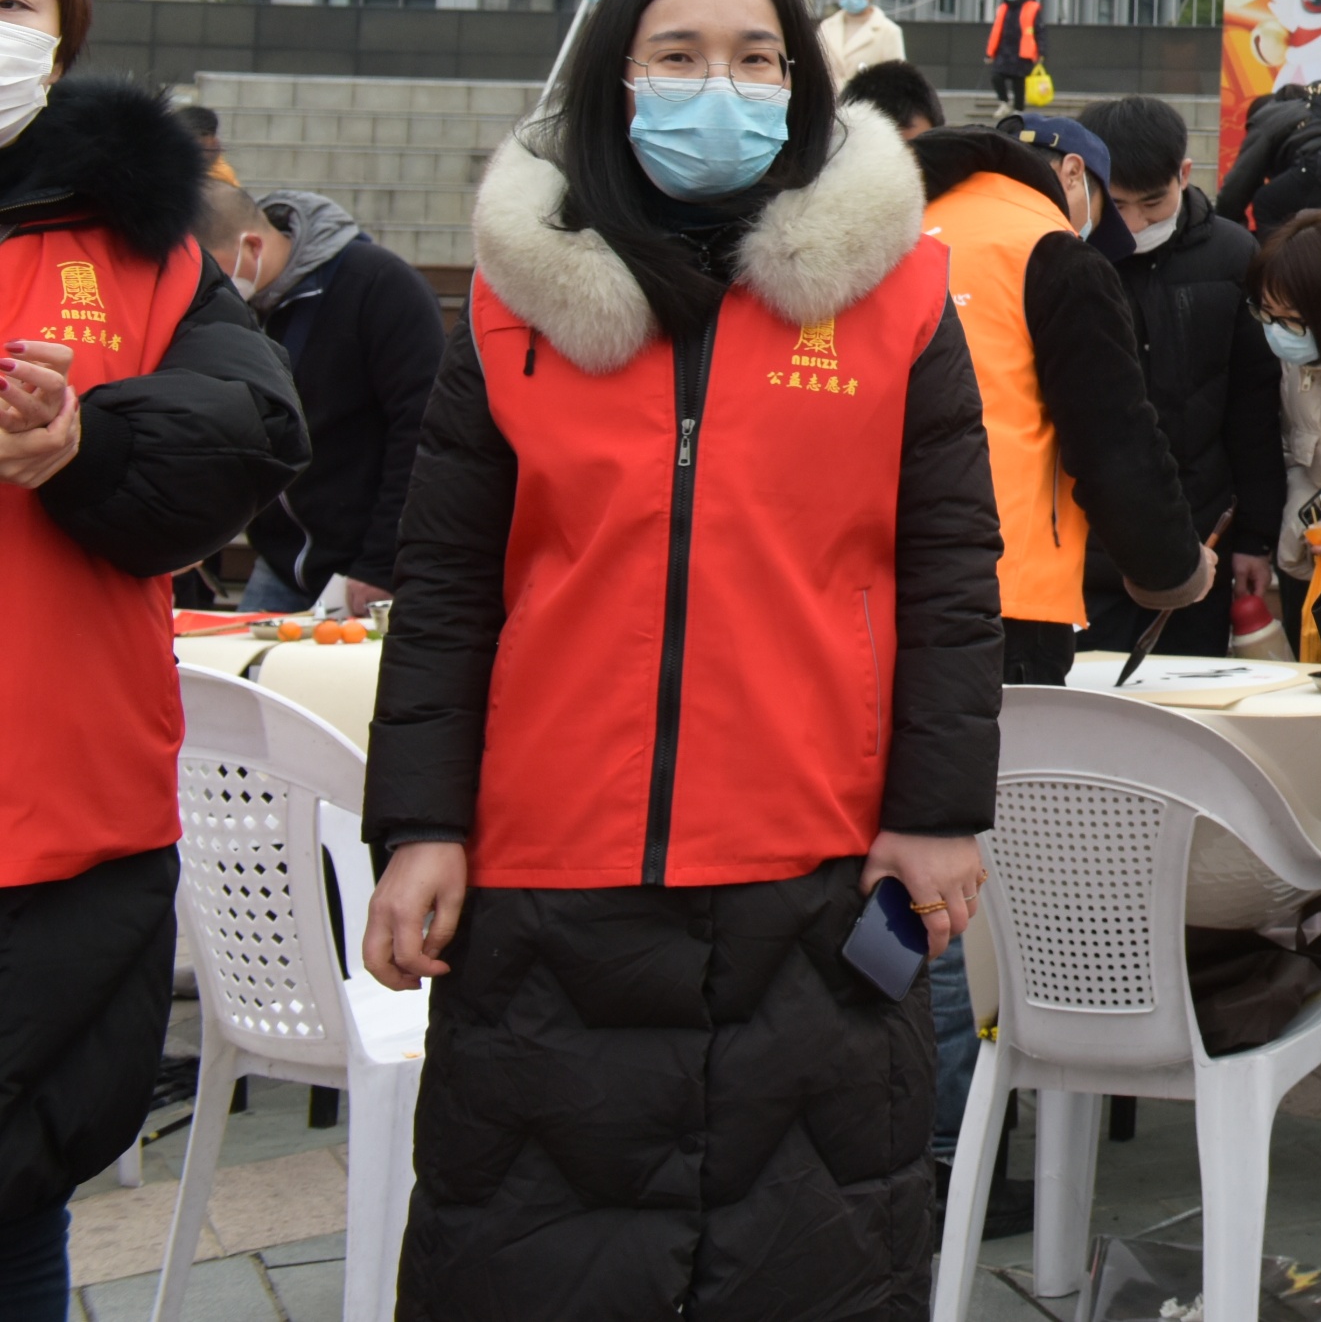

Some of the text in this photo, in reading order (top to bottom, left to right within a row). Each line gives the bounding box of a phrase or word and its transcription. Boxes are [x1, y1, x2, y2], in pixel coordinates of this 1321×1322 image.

[766, 371, 859, 397] 公益志愿者
